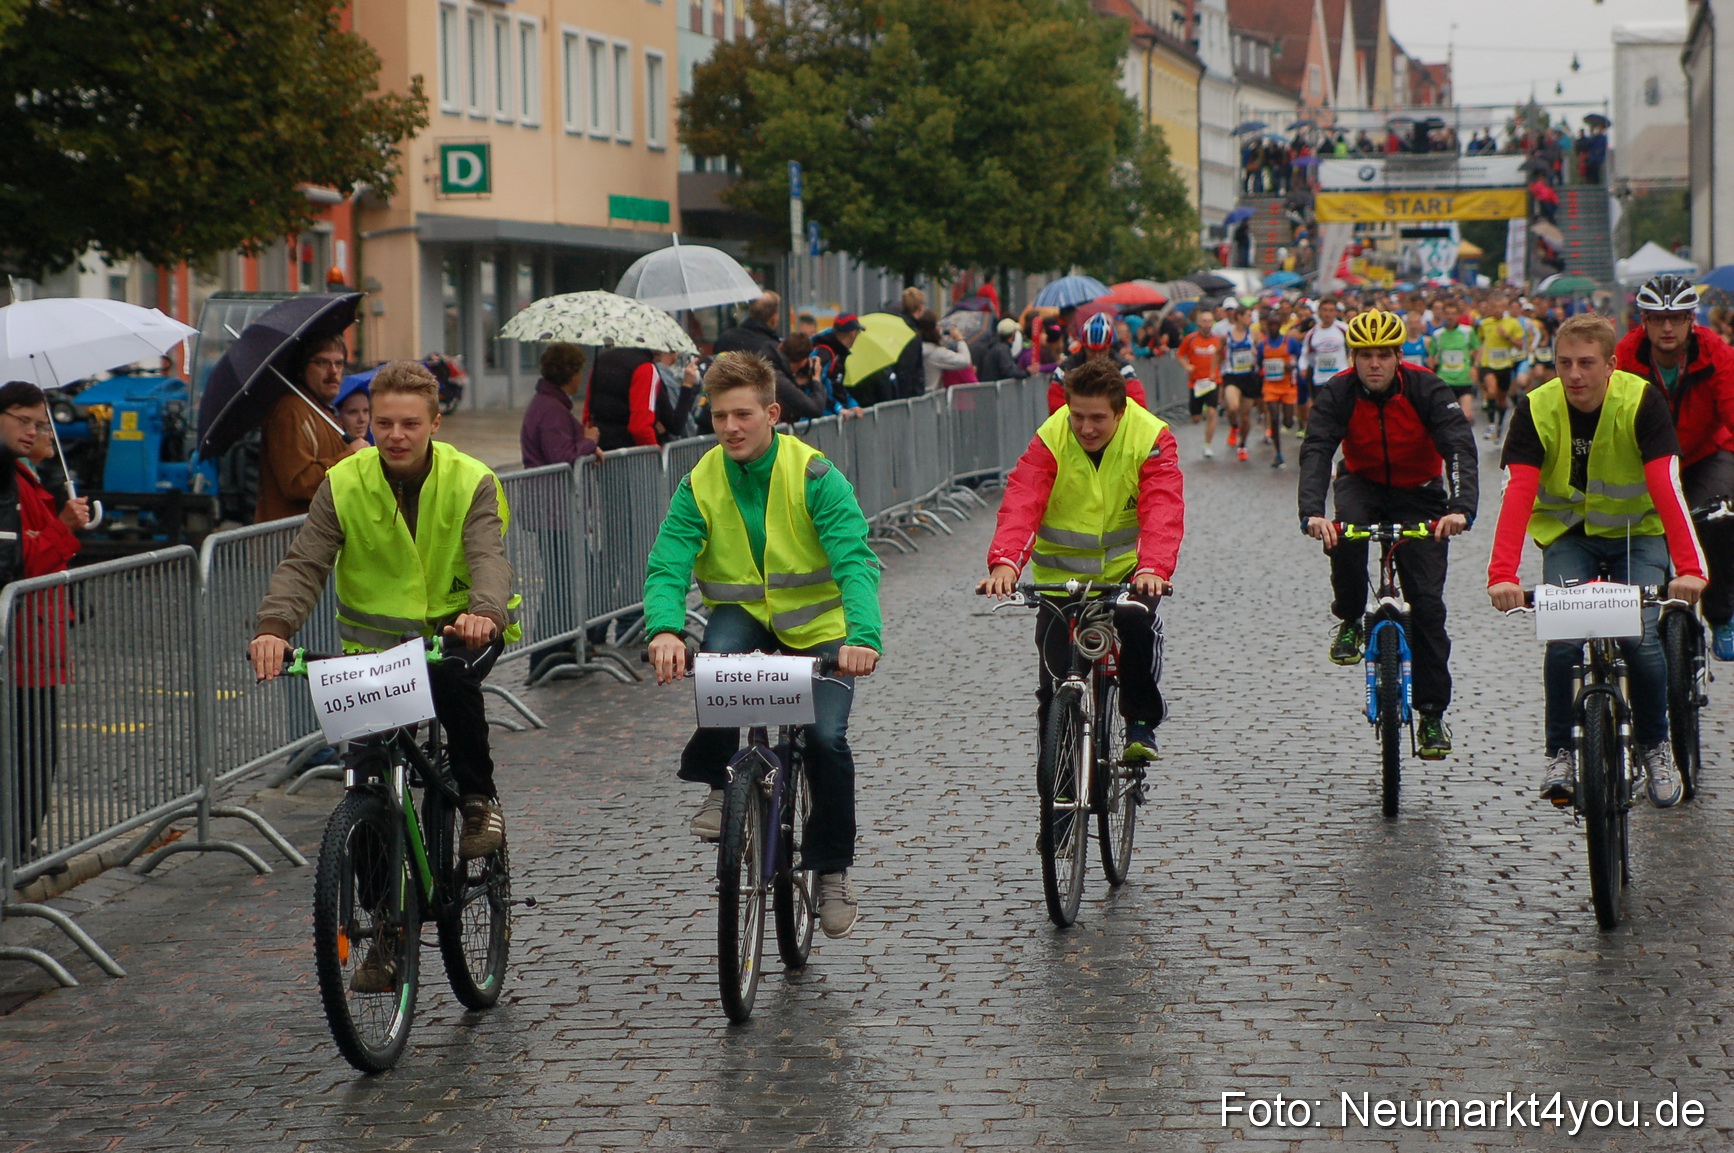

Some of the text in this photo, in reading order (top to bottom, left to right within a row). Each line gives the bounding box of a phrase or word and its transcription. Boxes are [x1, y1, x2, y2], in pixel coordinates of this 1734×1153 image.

[447, 151, 484, 187] D
[1384, 198, 1456, 216] START
[1545, 588, 1587, 596] Erster
[1538, 598, 1638, 611] Halbmarathon
[320, 657, 411, 687] Erster Mann
[715, 670, 789, 682] Erste Frau
[324, 678, 417, 714] 10,5 km Lauf
[706, 694, 801, 708] 10,5 km Lauf
